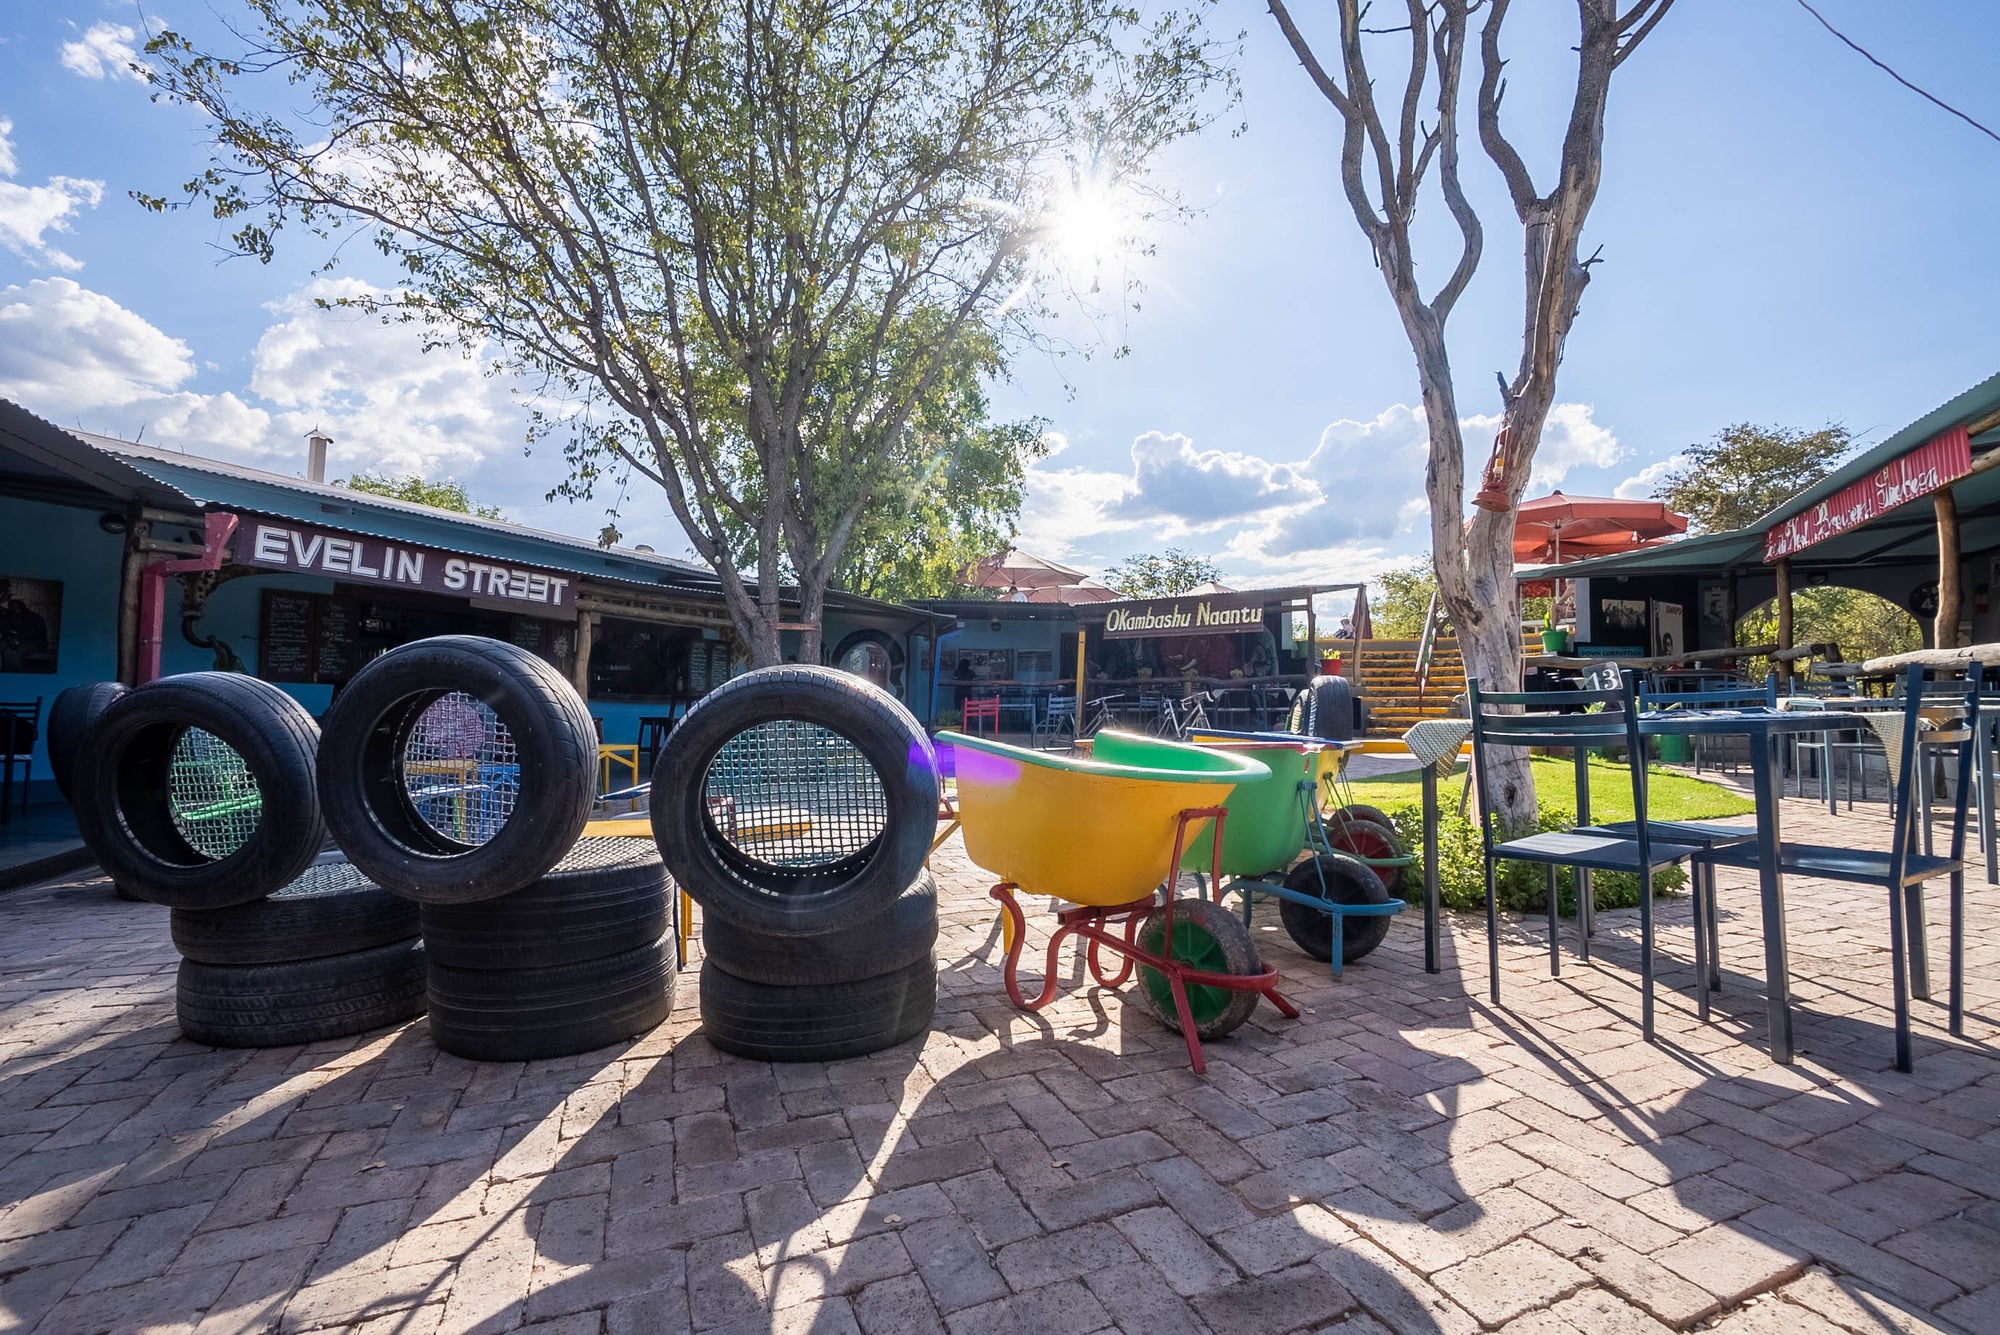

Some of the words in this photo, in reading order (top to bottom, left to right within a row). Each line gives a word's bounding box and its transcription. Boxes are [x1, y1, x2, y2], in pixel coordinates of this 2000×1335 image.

[254, 524, 425, 585] EVELIN
[443, 558, 569, 606] STREET
[1196, 601, 1263, 626] Naantu
[1586, 669, 1617, 690] 13
